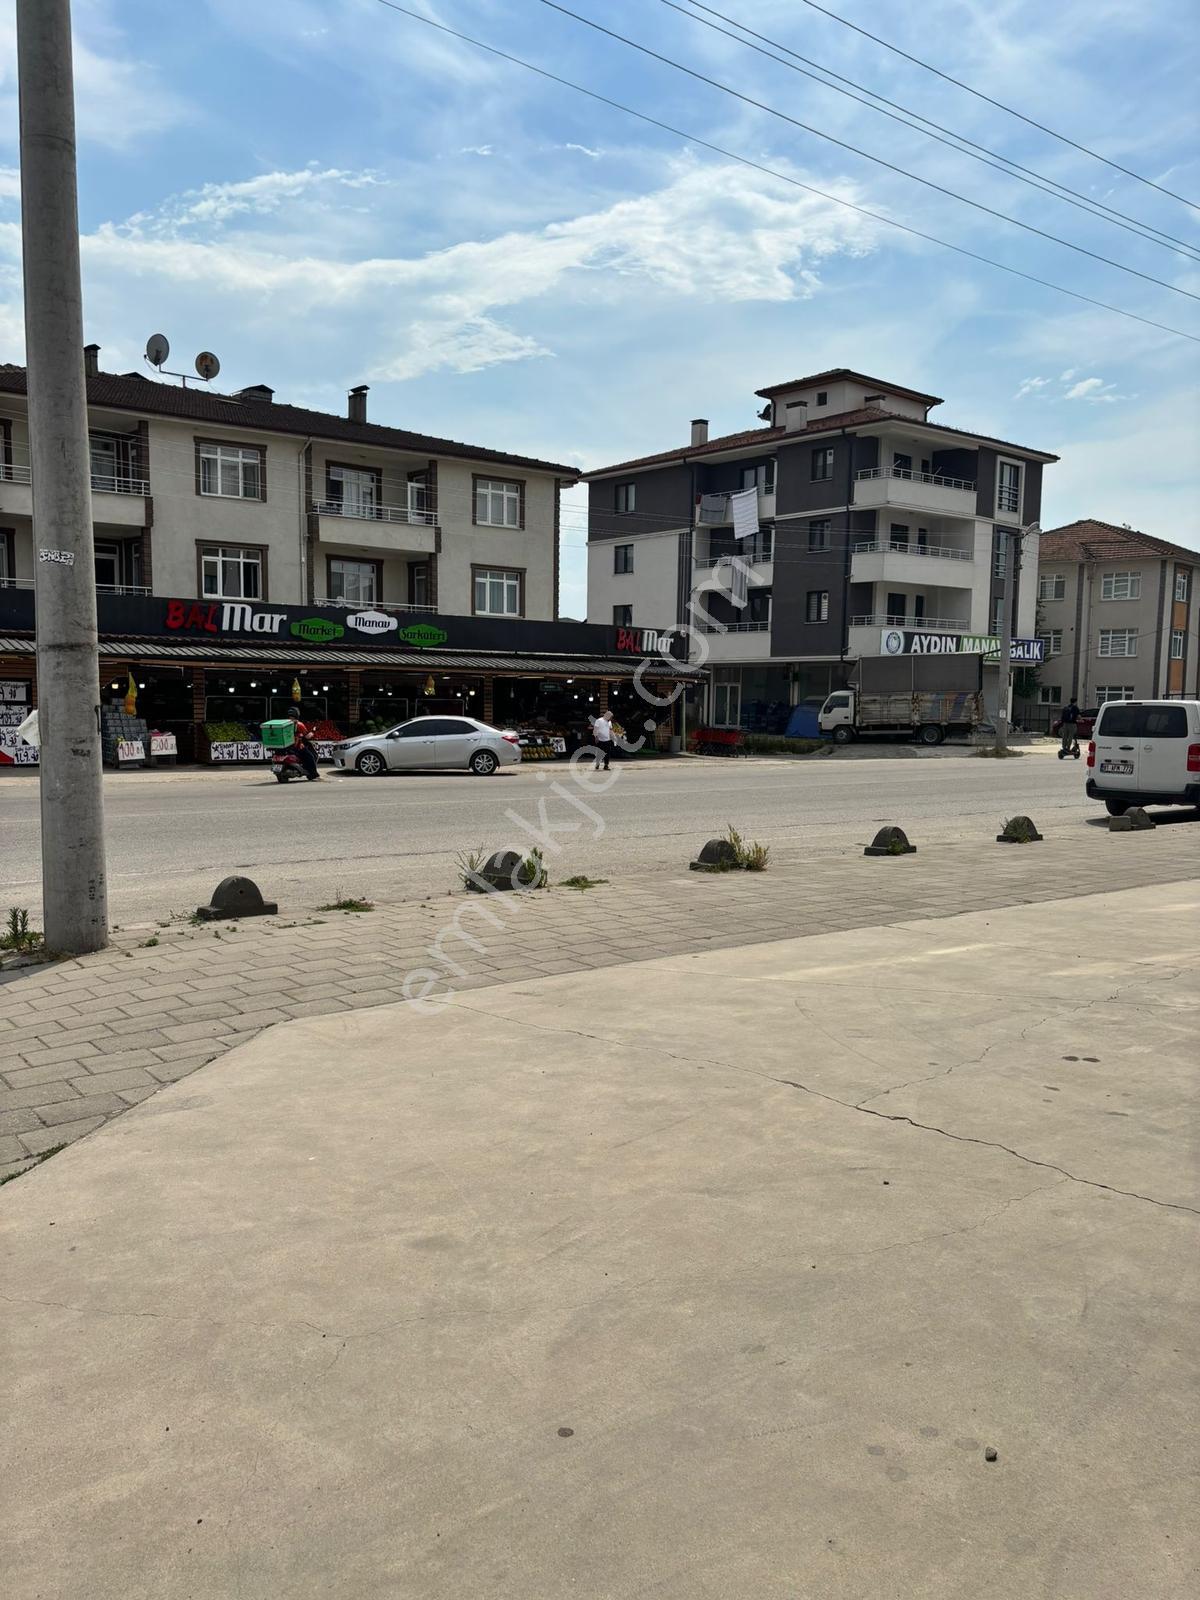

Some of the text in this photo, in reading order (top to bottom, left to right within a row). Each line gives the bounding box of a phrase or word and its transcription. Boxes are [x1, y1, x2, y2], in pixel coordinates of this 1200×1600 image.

[354, 616, 391, 629] Manav
[298, 623, 337, 637] Market
[910, 634, 957, 654] AYDIN
[119, 742, 135, 759] 100
[151, 738, 169, 751] 200
